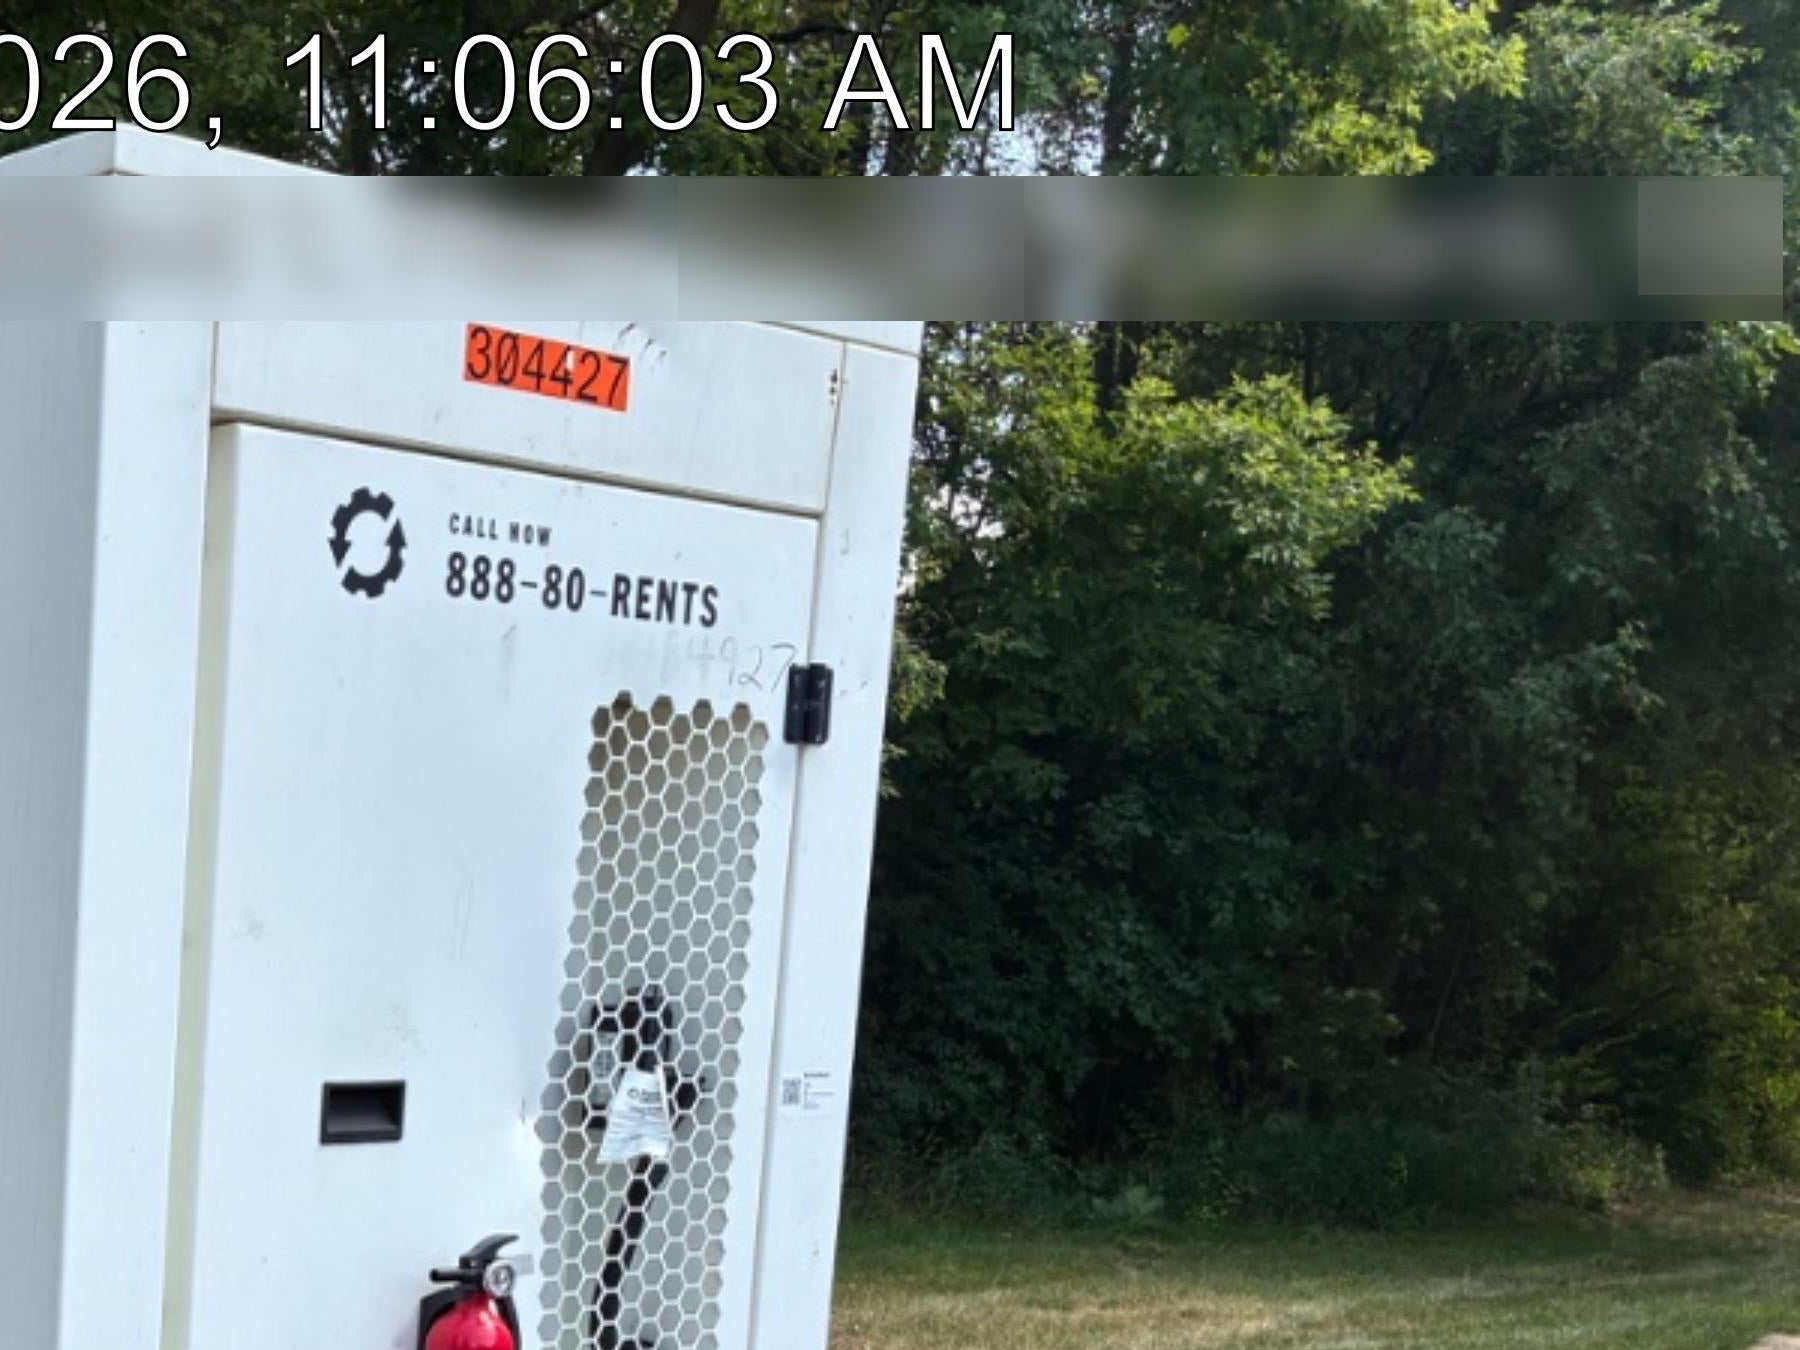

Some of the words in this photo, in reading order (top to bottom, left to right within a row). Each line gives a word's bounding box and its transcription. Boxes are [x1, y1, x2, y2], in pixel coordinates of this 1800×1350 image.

[466, 325, 630, 407] 304427
[449, 512, 499, 541] CALL
[509, 520, 552, 547] NOW
[446, 550, 719, 628] 888-80-RENTS
